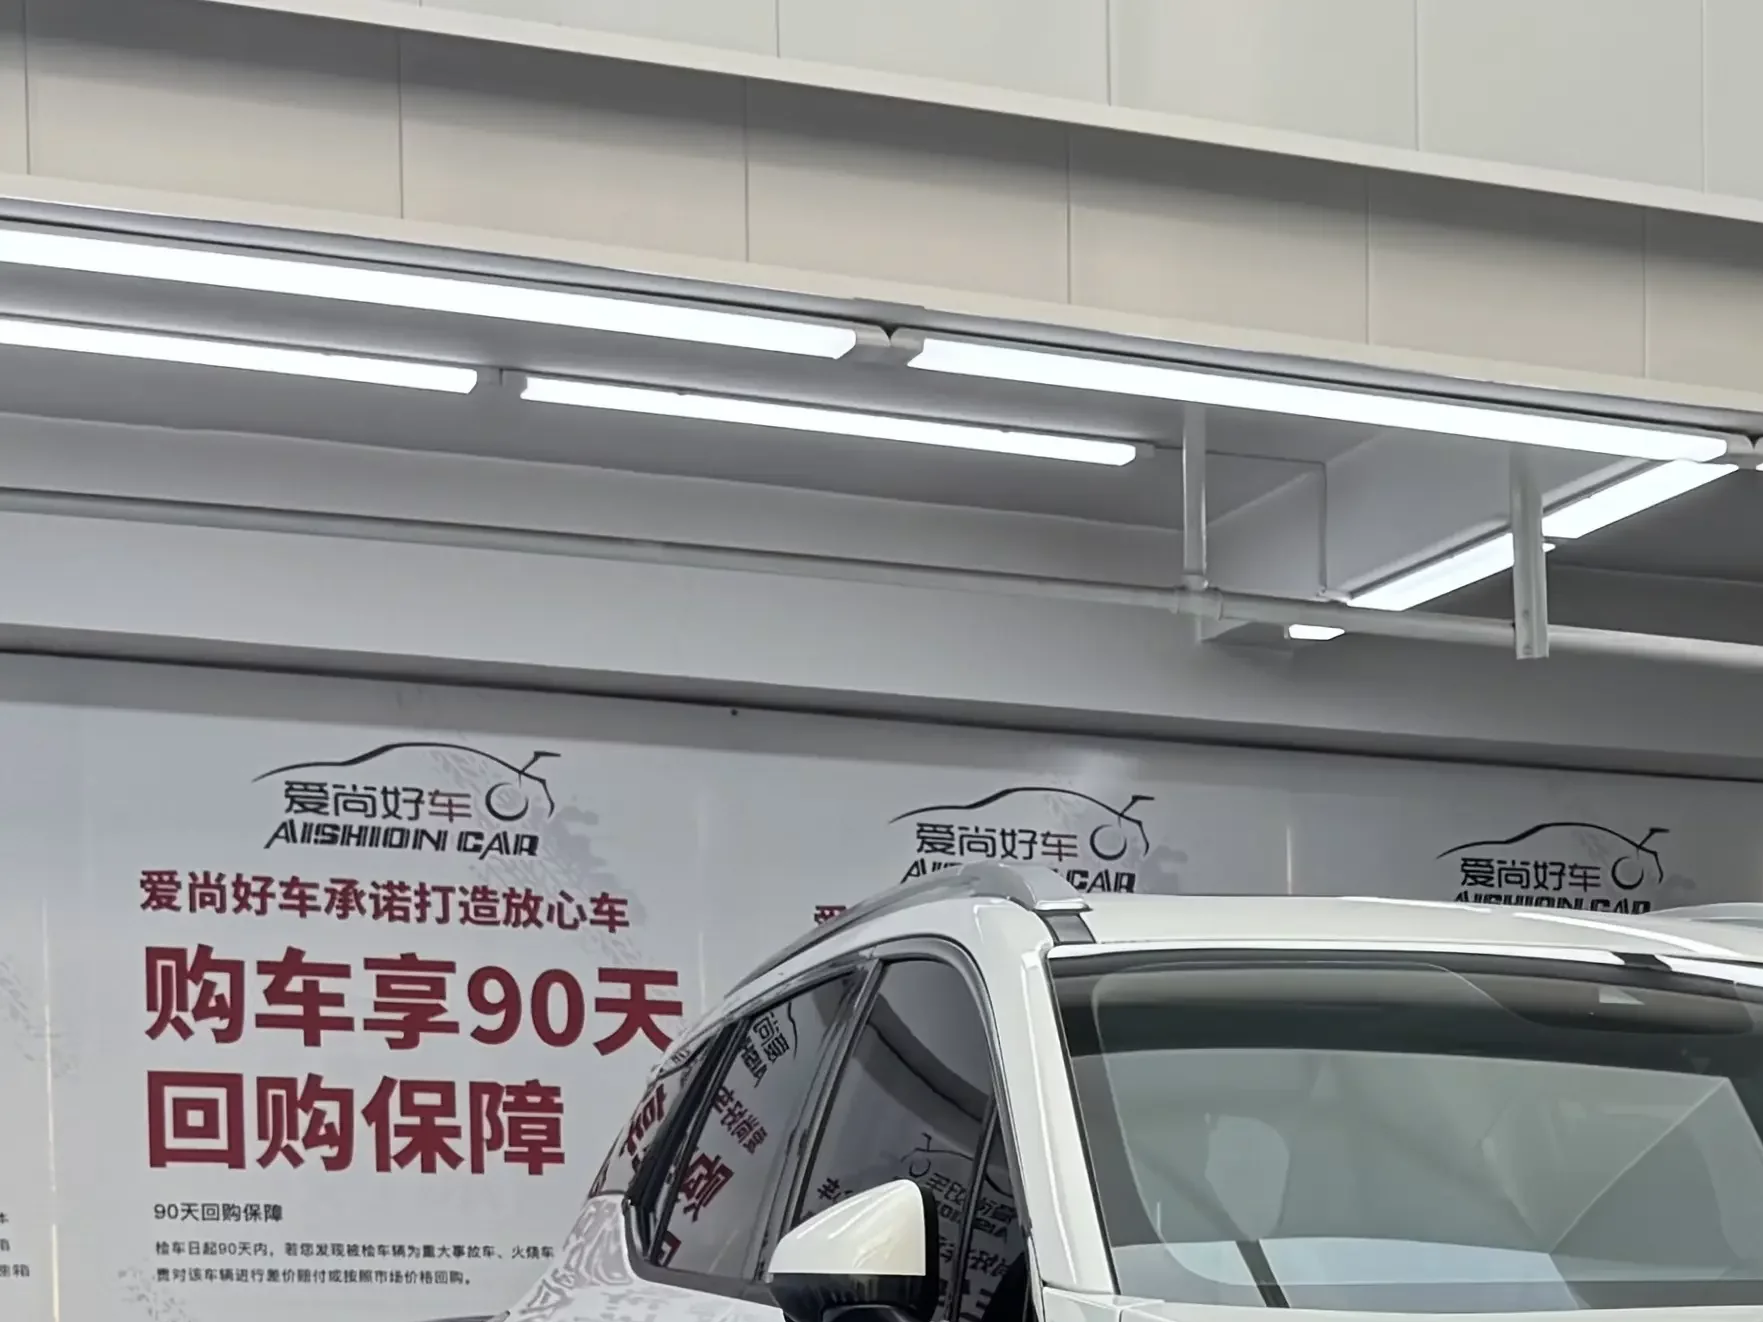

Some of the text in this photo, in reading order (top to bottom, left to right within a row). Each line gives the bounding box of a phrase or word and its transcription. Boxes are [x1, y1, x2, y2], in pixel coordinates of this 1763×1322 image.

[284, 780, 473, 823] 爱尚好车
[263, 818, 540, 860] AISHION CAR
[915, 822, 1079, 863] 爱尚好车
[1459, 856, 1603, 893] 爱尚好车
[139, 868, 631, 934] 爱尚好车承诺打造放心车
[143, 942, 685, 1057] 购车享90天
[145, 1070, 567, 1176] 回购保障
[153, 1201, 284, 1223] 90天回购保障
